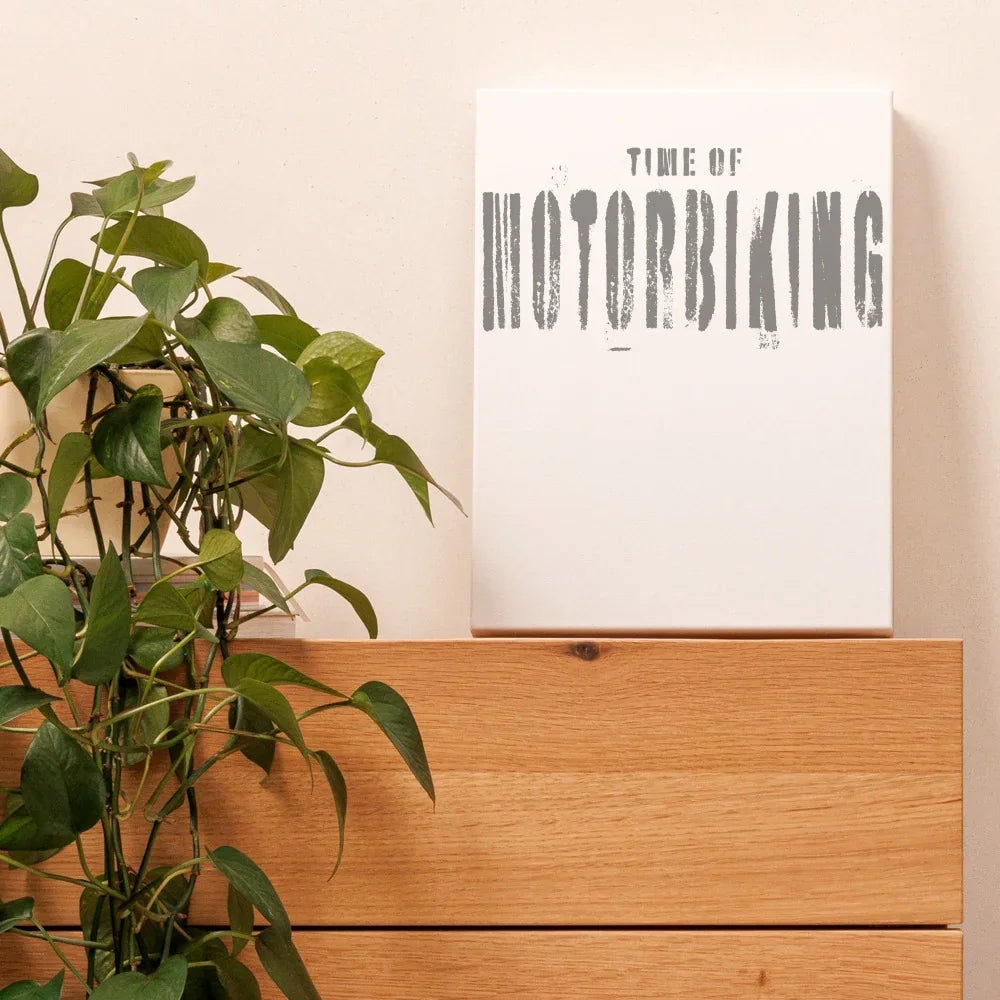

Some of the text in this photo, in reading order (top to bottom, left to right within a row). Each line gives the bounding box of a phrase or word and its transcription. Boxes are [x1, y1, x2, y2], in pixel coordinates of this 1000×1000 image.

[626, 147, 742, 176] TIME OF
[482, 189, 883, 332] MOTORBIKING
